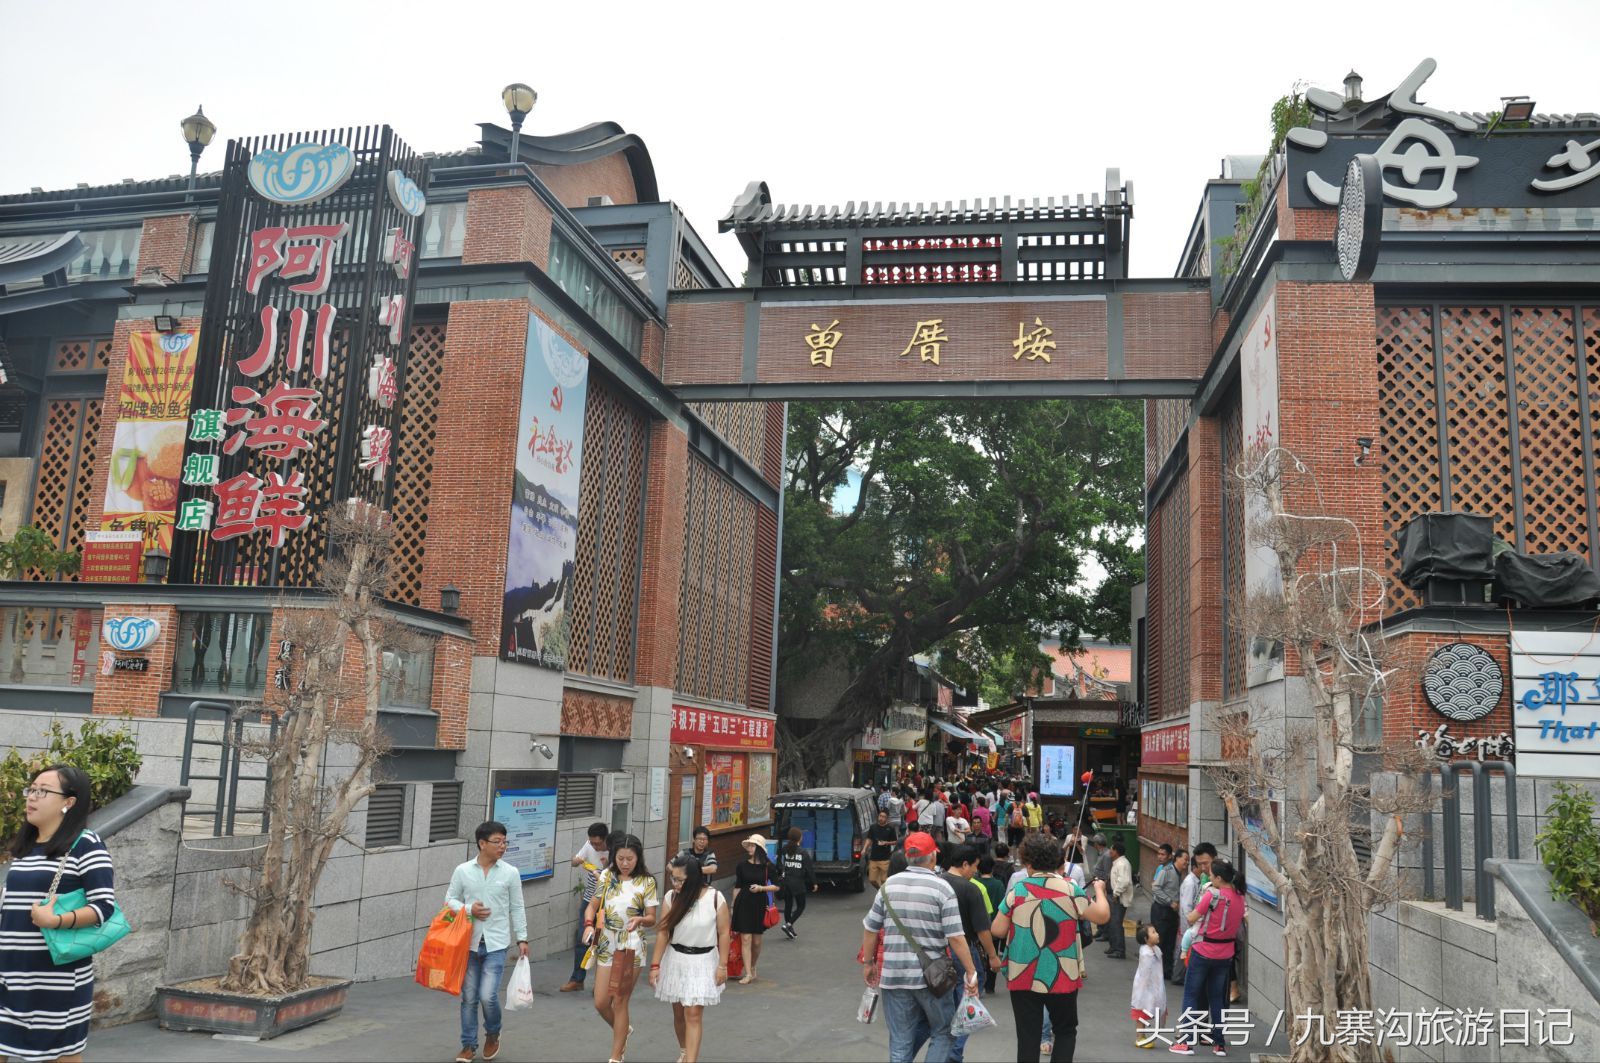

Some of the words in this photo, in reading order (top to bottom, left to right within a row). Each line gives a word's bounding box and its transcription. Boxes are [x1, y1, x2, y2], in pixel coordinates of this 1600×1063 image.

[211, 222, 350, 549] 阿川海鲜
[804, 316, 1057, 368] 曾厝垵
[176, 408, 227, 531] 旗舰店
[1538, 719, 1597, 743] That
